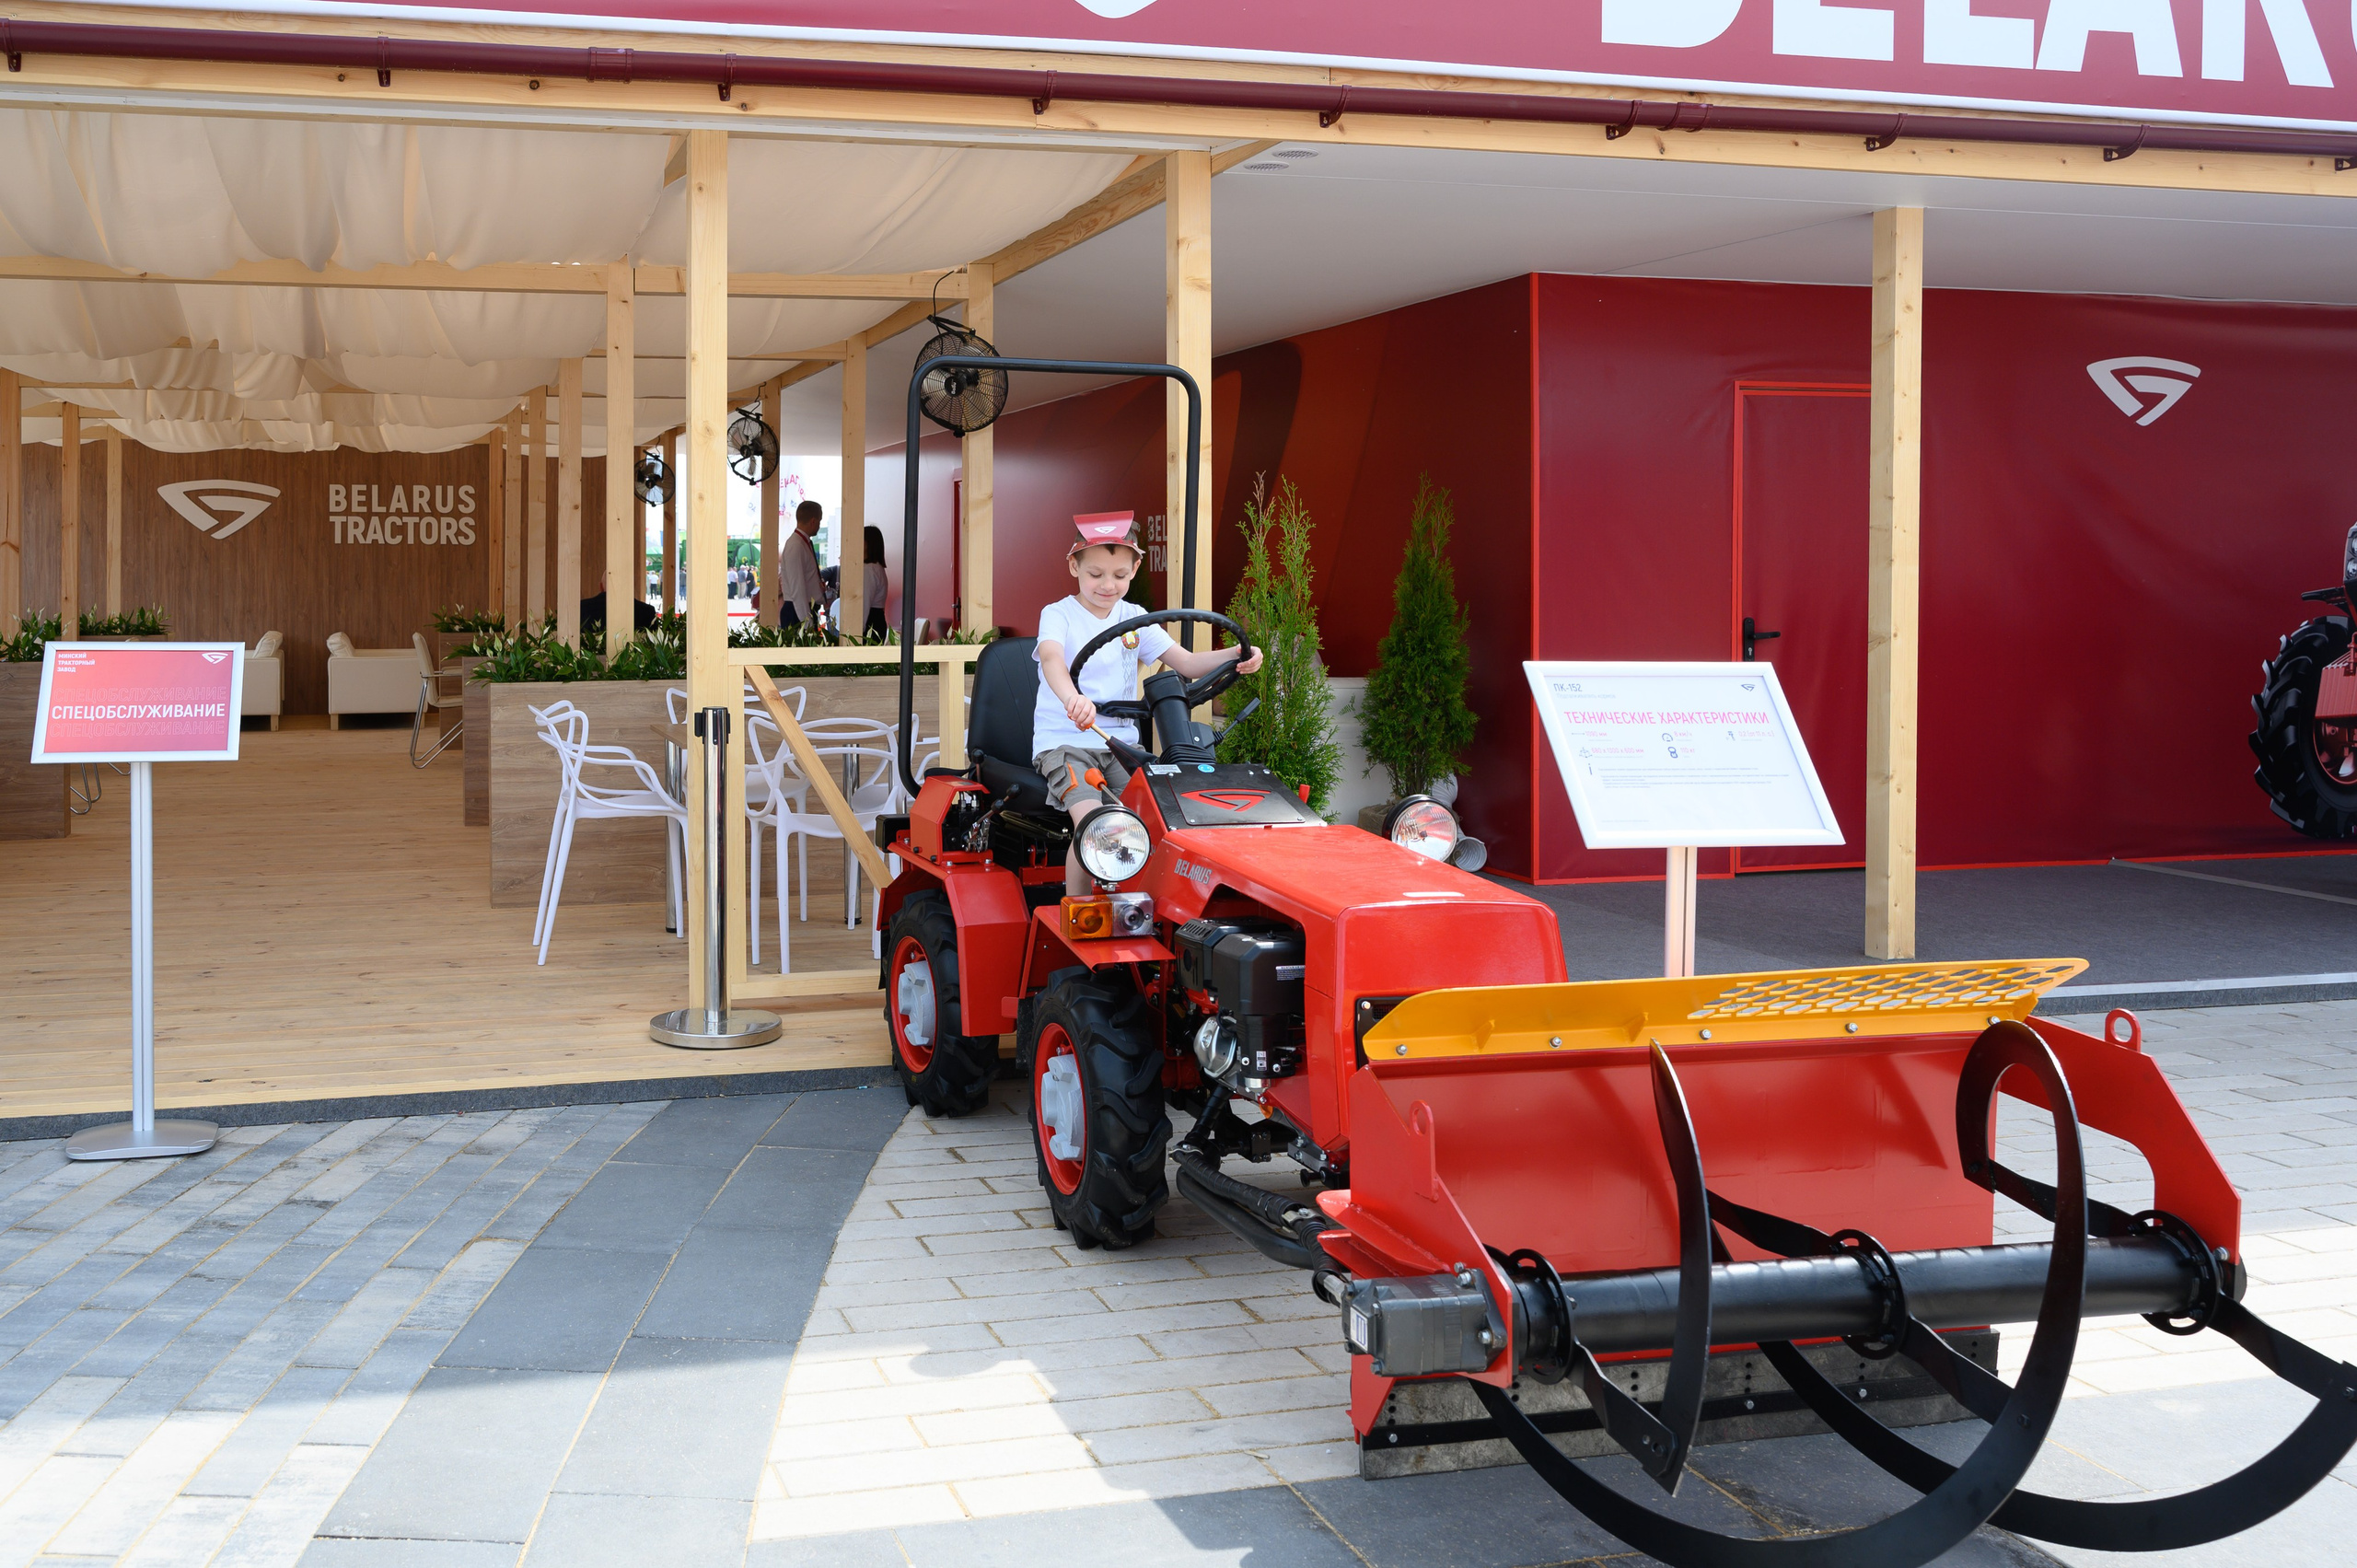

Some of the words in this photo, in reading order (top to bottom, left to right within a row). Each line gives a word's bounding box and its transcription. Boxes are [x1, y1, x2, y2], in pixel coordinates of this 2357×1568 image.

[329, 483, 477, 514] BELARUS
[329, 516, 477, 546] TRACTORS
[1147, 515, 1167, 541] BEL
[1148, 545, 1167, 572] TRA
[54, 686, 226, 703] СПЕЦОБСЛУЖИВАНИЕ
[1553, 683, 1583, 692] ПК-152
[52, 703, 226, 721] СПЕЦОБСЛУЖИВАНИЕ
[1563, 711, 1656, 725] ТЕХНИЧЕСКИЕ
[1657, 711, 1770, 725] ХАРАКТЕРИСТИКИ
[50, 722, 225, 738] СПЕЦОБСЛУЖИВАНИЕ
[1174, 858, 1213, 884] BELARUS
